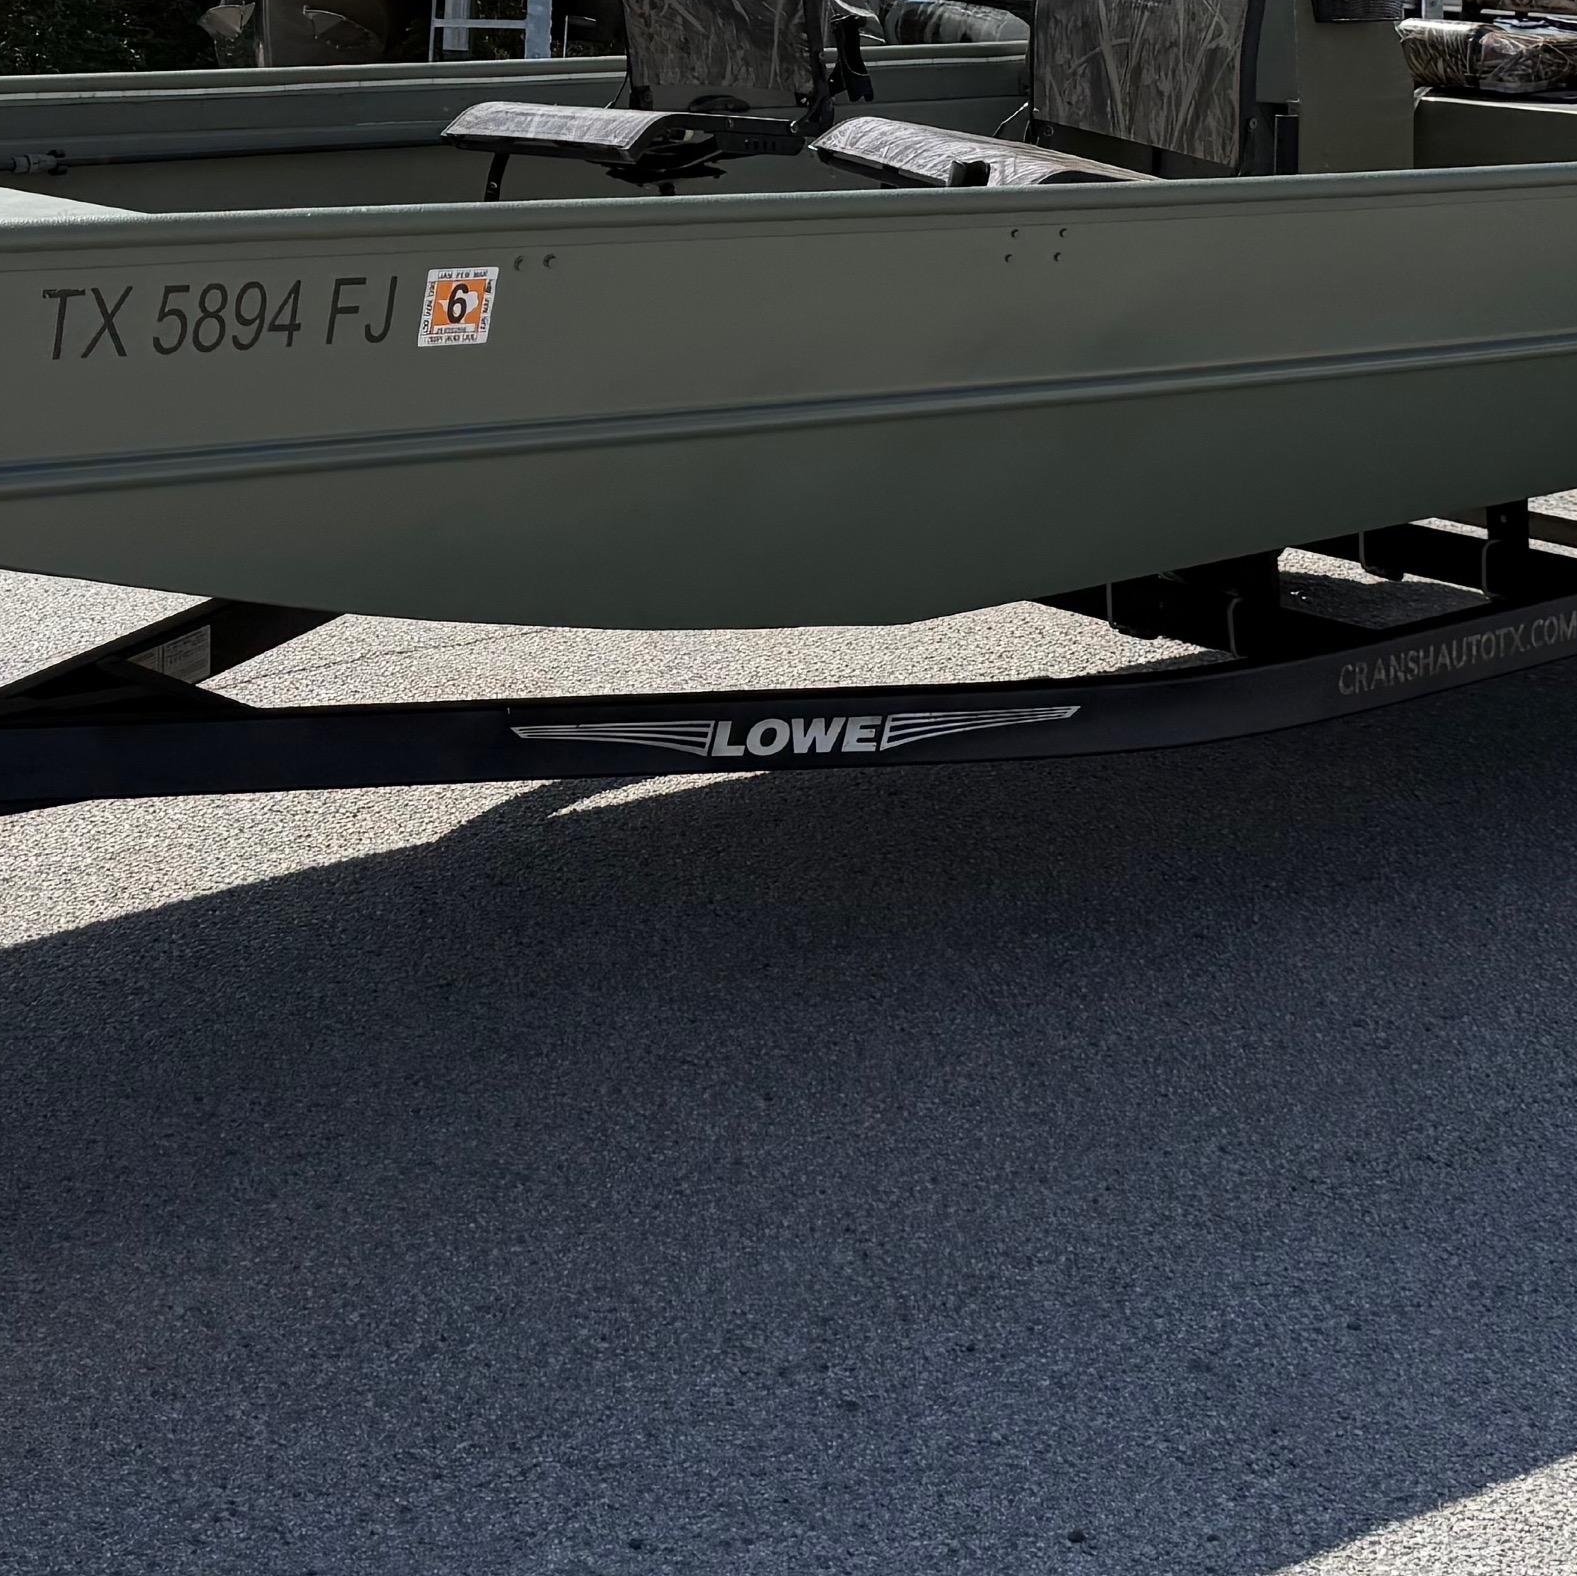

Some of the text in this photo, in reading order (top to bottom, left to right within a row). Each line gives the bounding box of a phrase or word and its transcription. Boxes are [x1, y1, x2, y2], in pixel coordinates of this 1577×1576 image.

[42, 287, 131, 359] TX
[152, 279, 304, 357] 5894
[325, 275, 398, 345] FJ
[447, 283, 469, 324] 6
[1337, 609, 1577, 695] CRANSHAUTOTX.COM
[710, 715, 883, 757] LOWE
